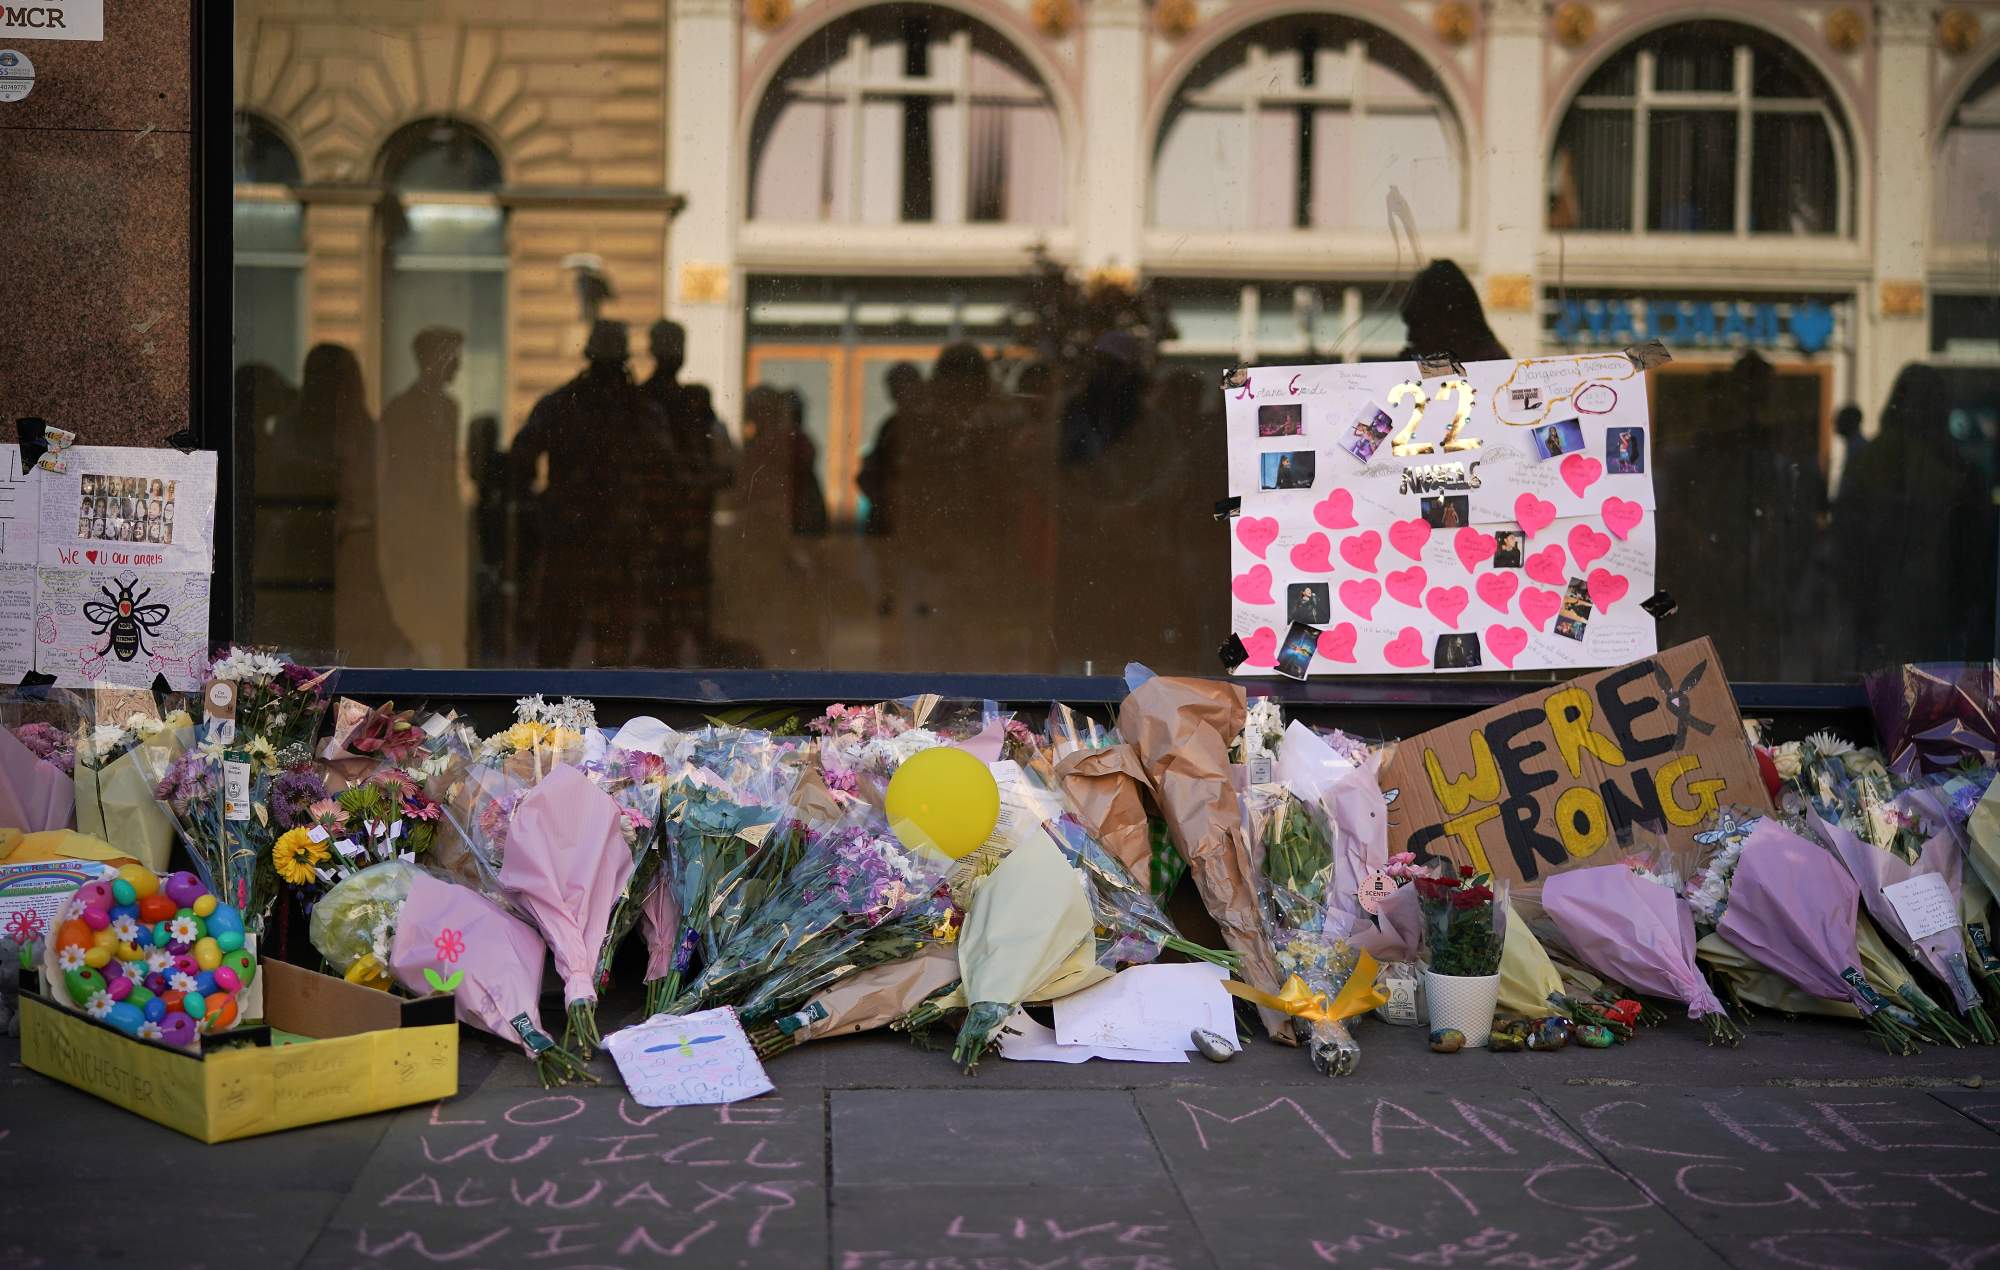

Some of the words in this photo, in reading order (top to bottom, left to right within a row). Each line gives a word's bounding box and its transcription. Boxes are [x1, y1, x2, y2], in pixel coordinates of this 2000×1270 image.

[5, 6, 66, 28] MCR
[1387, 379, 1483, 456] 22
[57, 547, 80, 565] We
[100, 550, 108, 565] U
[133, 553, 163, 567] angels
[1423, 659, 1679, 815] WERE
[1407, 754, 1727, 882] STRONG
[429, 1096, 786, 1126] LOVE
[1176, 1096, 2000, 1159] MANCHE
[420, 1133, 805, 1168] WILL
[946, 1214, 1169, 1248] LIVE
